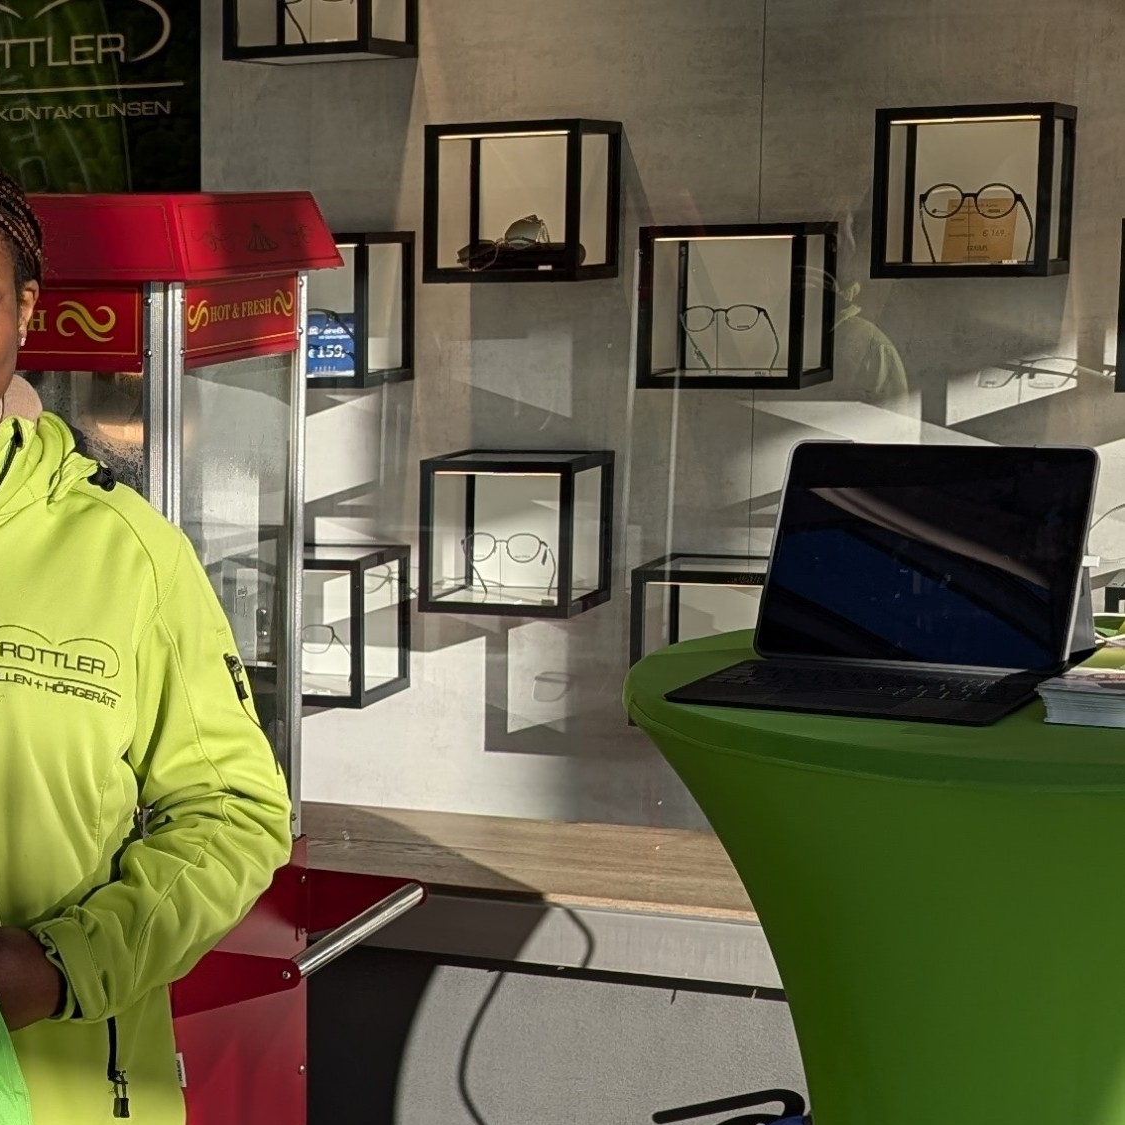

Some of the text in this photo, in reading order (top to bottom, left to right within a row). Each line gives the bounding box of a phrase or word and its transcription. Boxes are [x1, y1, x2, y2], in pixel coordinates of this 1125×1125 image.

[210, 298, 272, 322] HOT & FRESH
[0, 641, 106, 678] ROTTLER
[44, 681, 117, 709] HÖRGERÄTE
